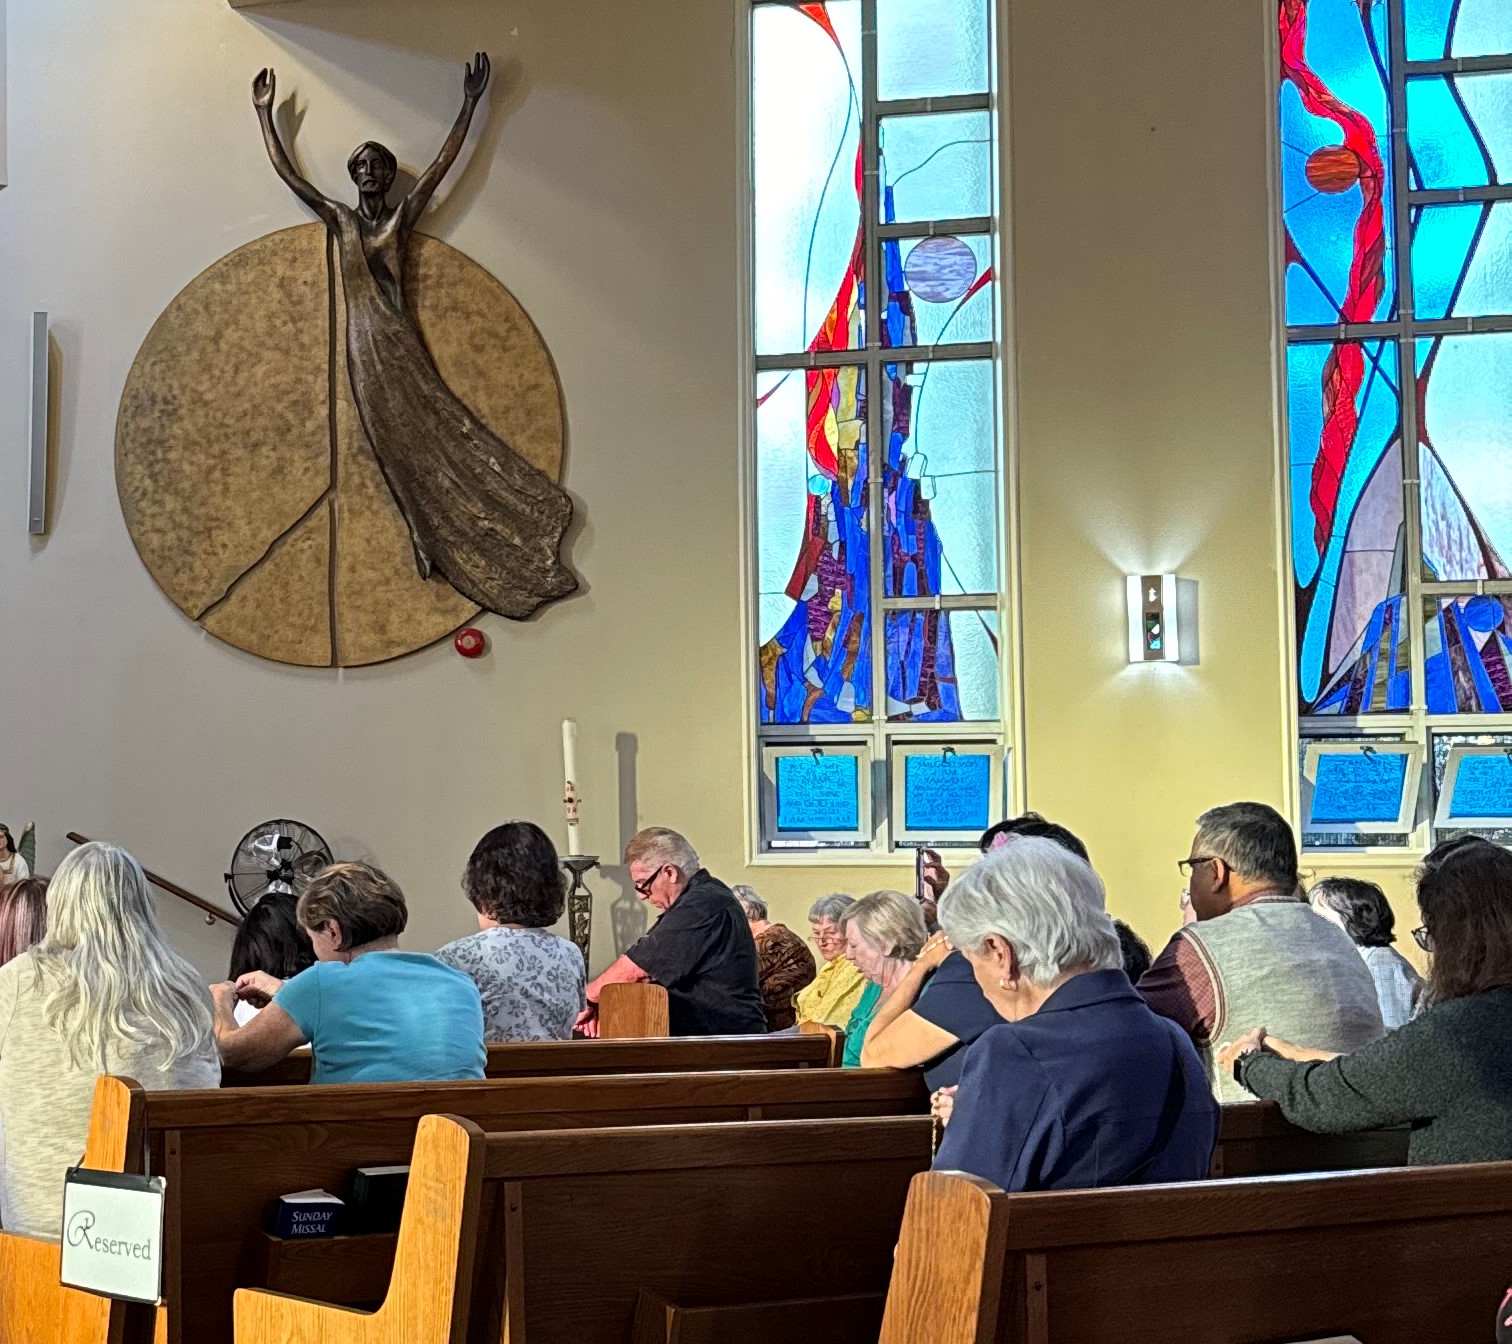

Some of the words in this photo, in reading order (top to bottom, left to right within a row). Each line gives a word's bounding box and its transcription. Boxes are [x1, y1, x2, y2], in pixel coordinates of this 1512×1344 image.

[291, 1211, 333, 1222] SUNDAY
[67, 1209, 151, 1261] Reserved
[291, 1223, 327, 1235] MISSAL
